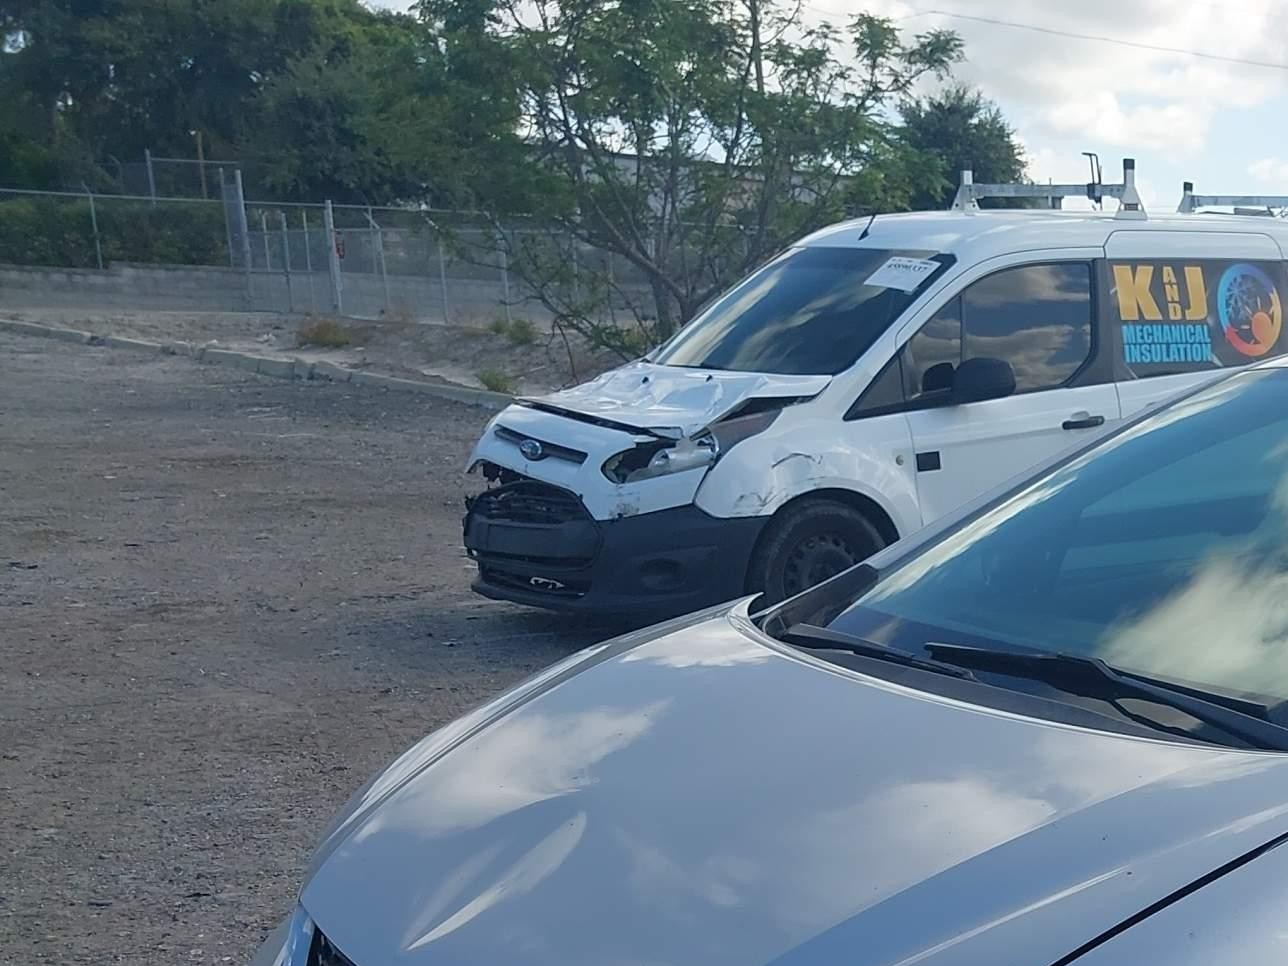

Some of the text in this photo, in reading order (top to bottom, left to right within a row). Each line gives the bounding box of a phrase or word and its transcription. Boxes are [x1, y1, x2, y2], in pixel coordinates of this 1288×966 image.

[1112, 264, 1164, 321] K
[1184, 265, 1208, 321] J
[1121, 324, 1212, 344] MECHANICAL
[1123, 343, 1212, 364] INSULATION
